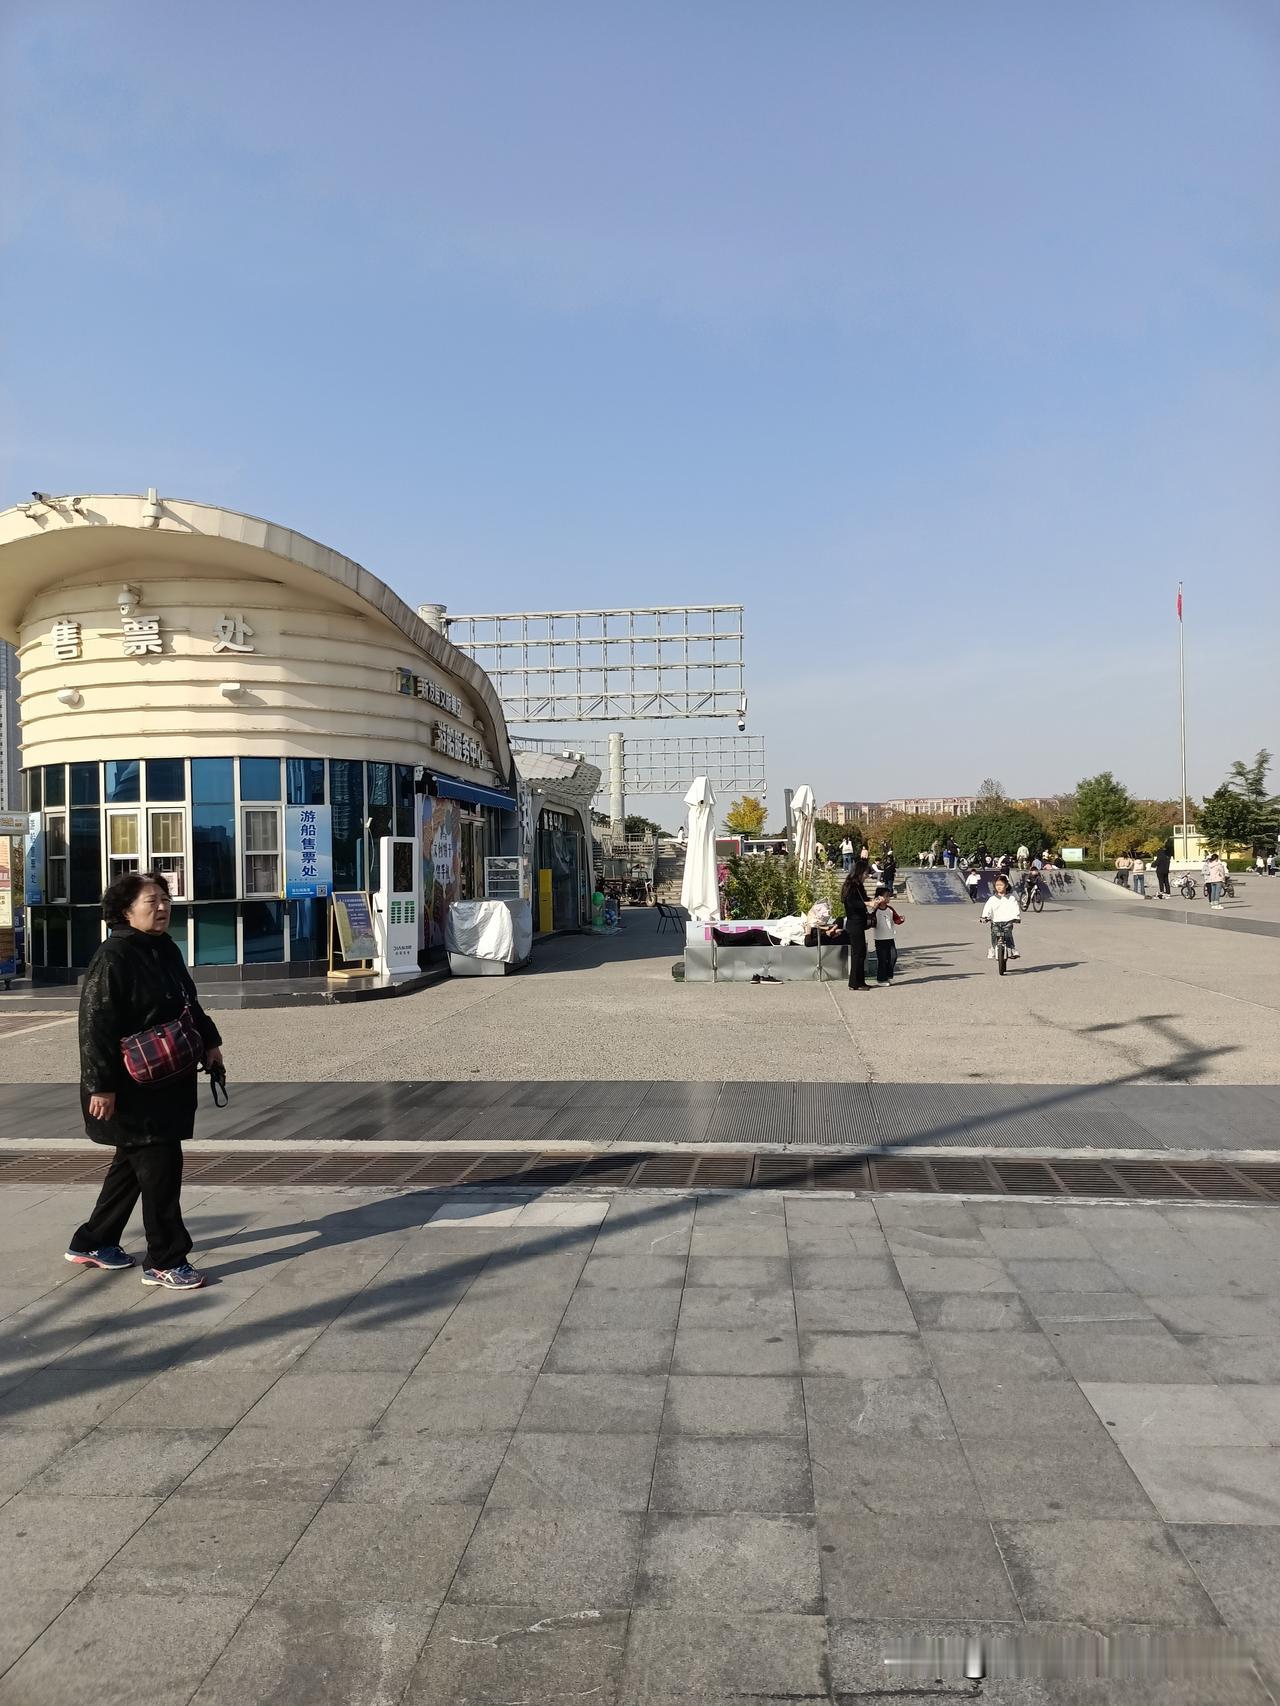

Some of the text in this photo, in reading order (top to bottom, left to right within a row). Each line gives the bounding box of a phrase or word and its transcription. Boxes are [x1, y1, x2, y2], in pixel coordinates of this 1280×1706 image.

[51, 614, 254, 660] 售票处
[435, 720, 493, 769] 游船服务中心
[300, 811, 317, 877] 游船售票处
